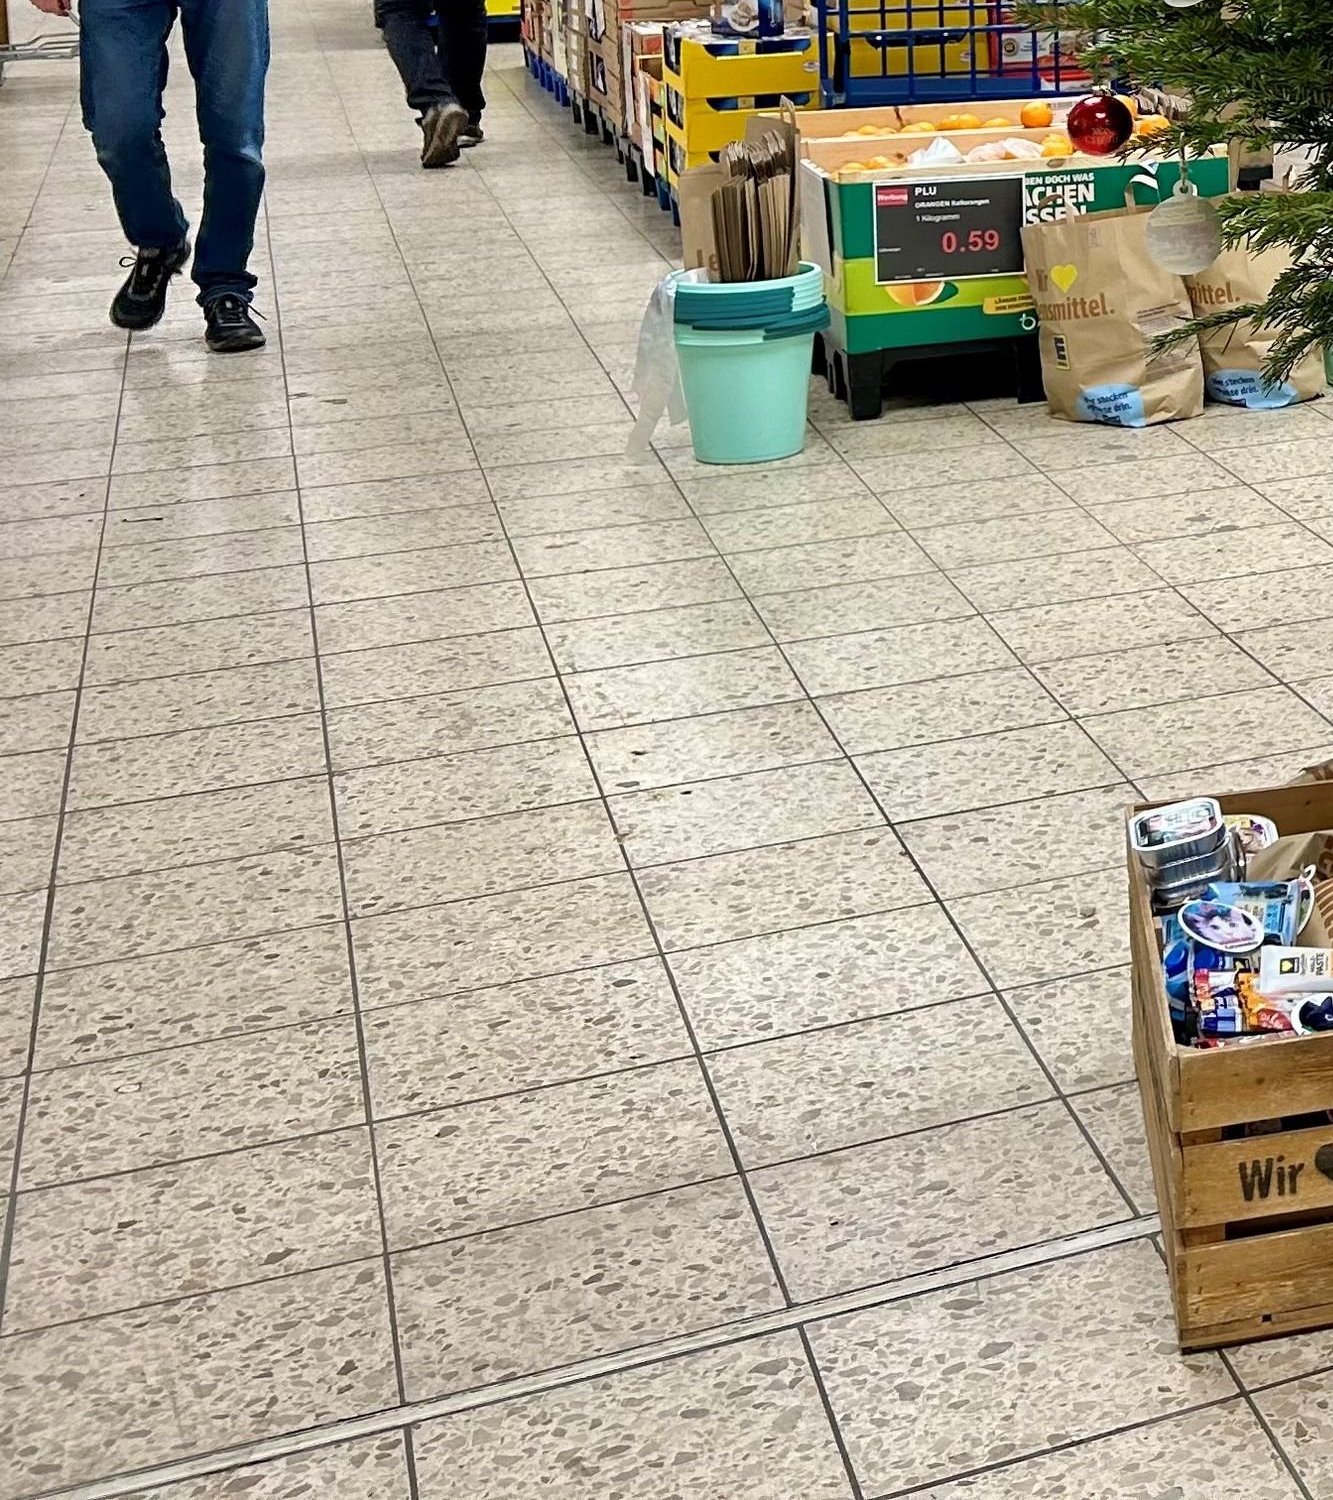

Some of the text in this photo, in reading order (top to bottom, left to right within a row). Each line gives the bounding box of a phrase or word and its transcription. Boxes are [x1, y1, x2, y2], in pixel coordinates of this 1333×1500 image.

[1045, 175, 1070, 185] DOCH
[1071, 172, 1095, 182] WAS
[914, 186, 937, 196] PLU
[922, 213, 960, 223] Kilogramm
[942, 229, 1000, 254] 0.59
[1315, 952, 1325, 977] PASTE
[1238, 1155, 1305, 1202] Wir
